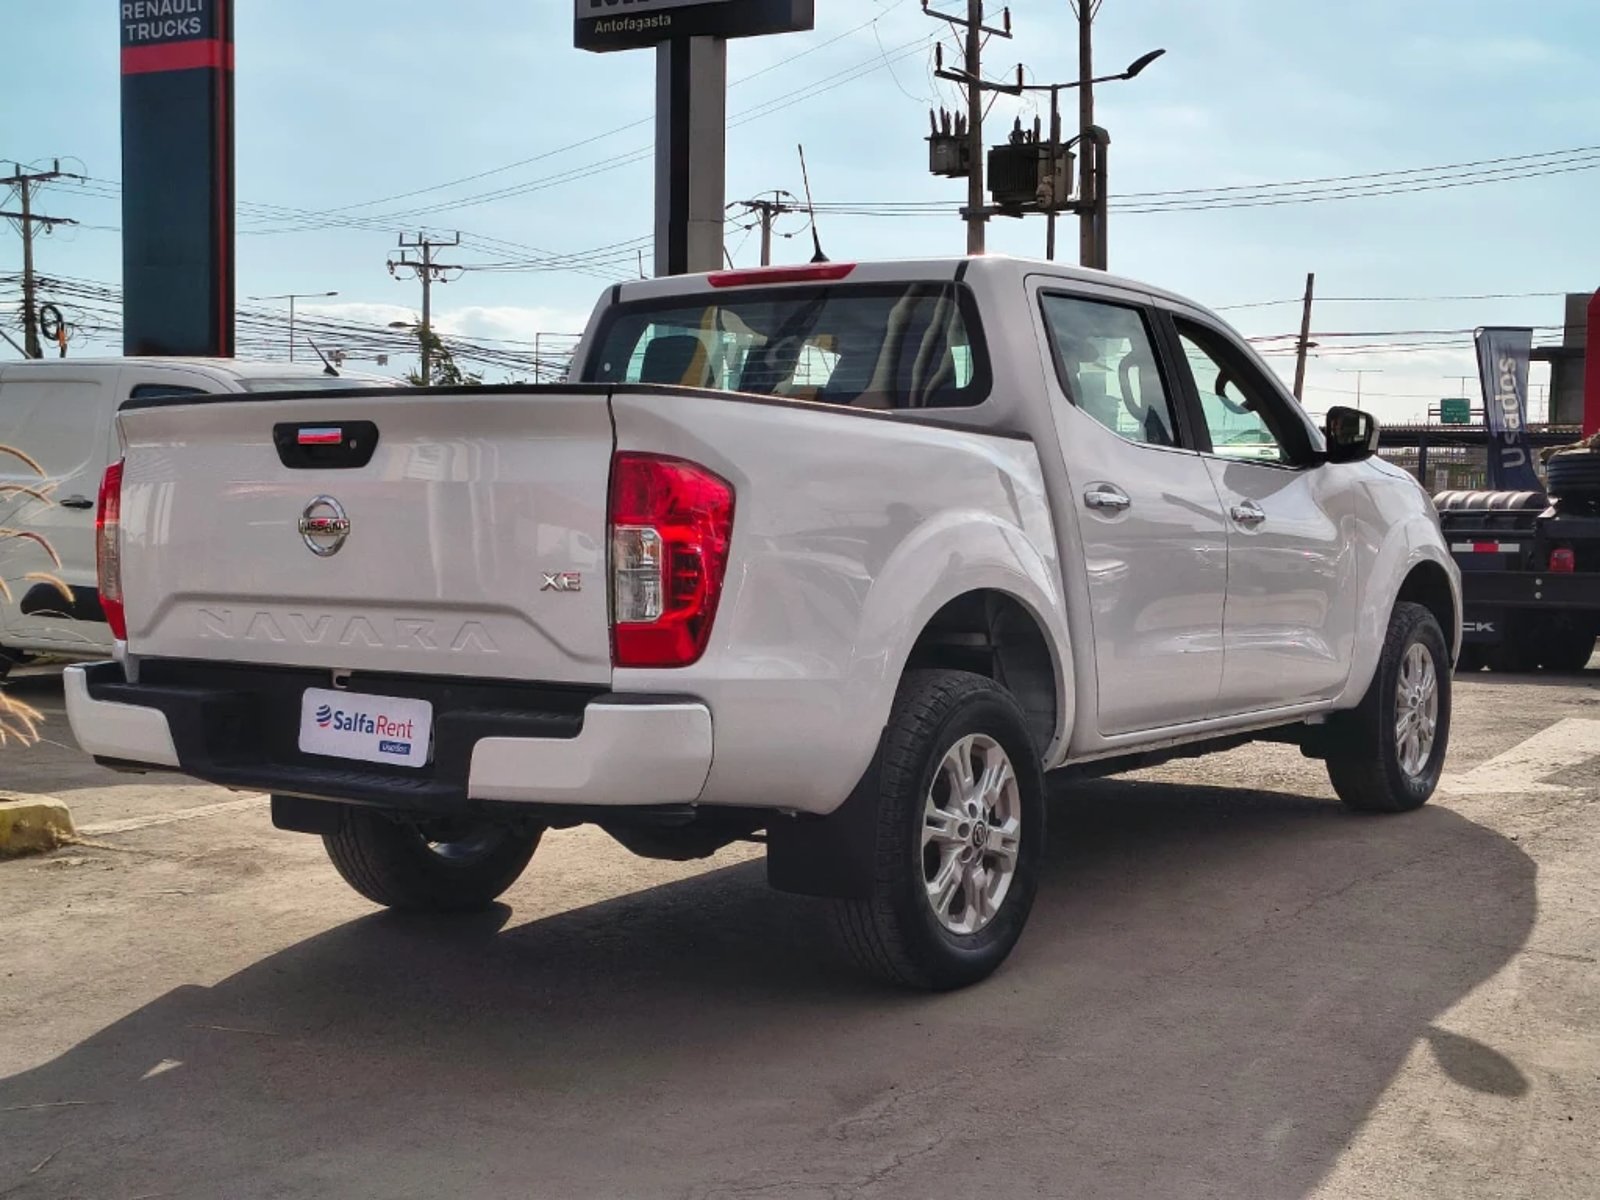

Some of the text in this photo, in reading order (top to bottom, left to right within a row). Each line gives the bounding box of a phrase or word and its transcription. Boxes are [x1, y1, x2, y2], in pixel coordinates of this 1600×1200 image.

[121, 0, 203, 19] RENAULT
[125, 17, 201, 41] TRUCKS
[594, 14, 672, 34] Antofagasta
[1494, 357, 1526, 468] Usados
[539, 572, 582, 592] XE
[198, 608, 500, 653] NAVARA
[333, 710, 414, 740] SalfaRent
